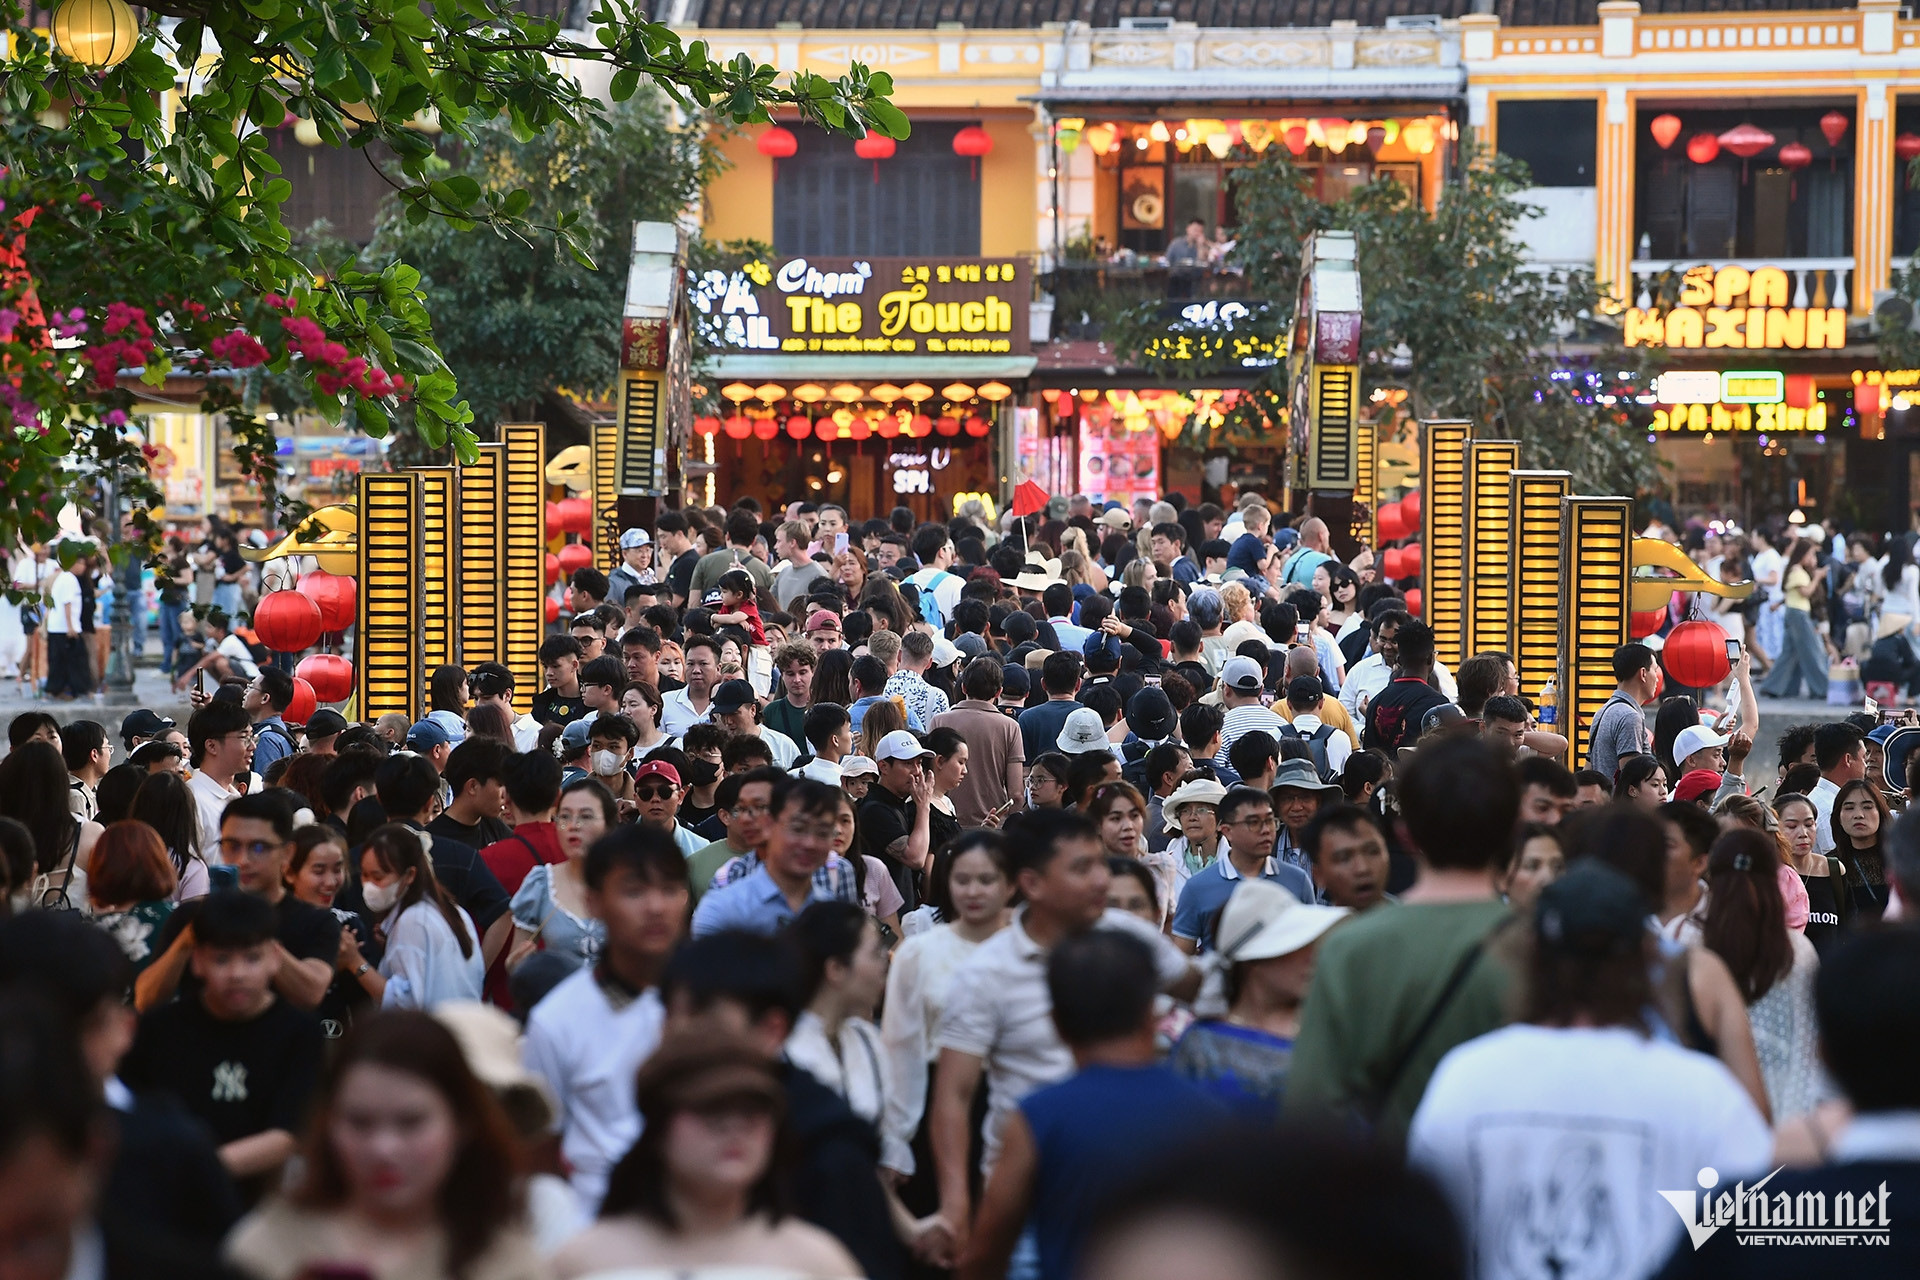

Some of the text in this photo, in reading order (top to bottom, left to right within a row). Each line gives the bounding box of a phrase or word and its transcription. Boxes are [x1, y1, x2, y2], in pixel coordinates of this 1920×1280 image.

[1680, 265, 1788, 306] SPA
[785, 283, 1012, 336] The Touch
